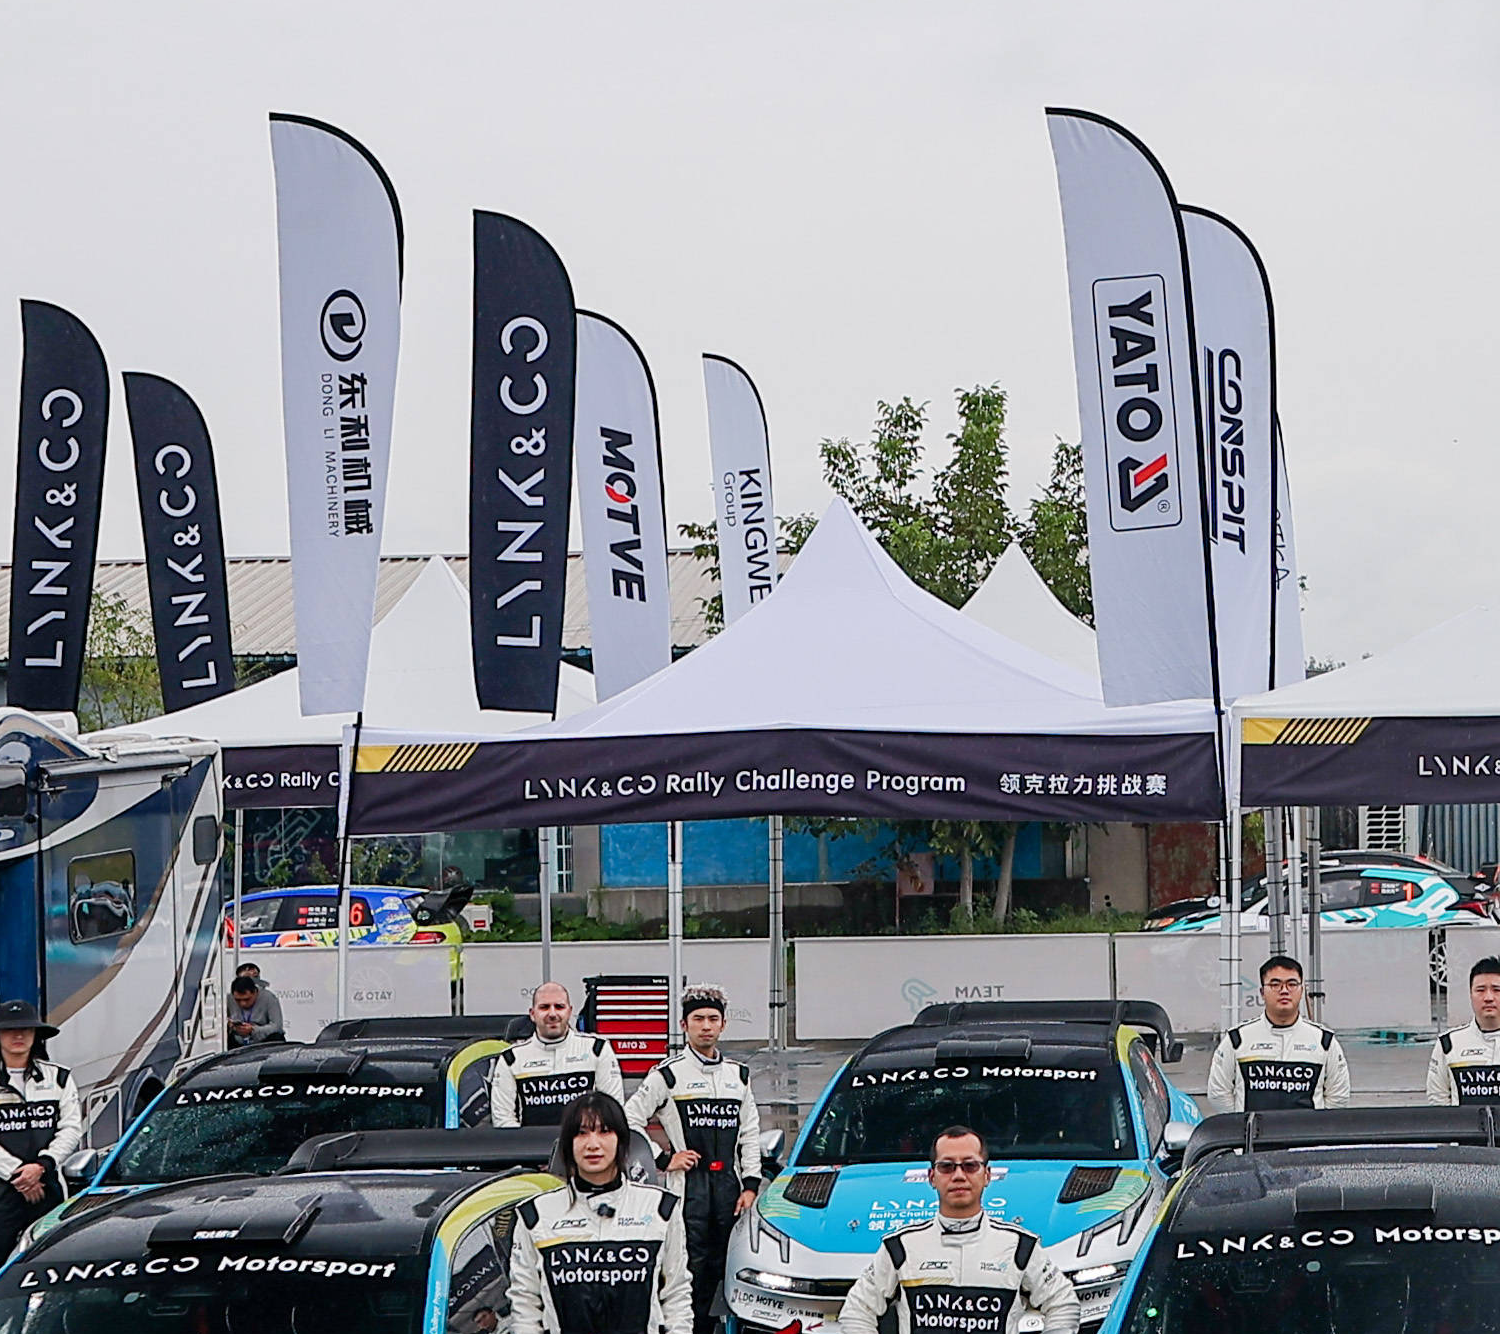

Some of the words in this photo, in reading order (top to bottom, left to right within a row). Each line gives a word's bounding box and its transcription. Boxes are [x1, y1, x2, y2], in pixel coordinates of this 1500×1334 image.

[1108, 290, 1163, 443] YATO
[321, 373, 334, 416] DONG
[324, 428, 335, 439] LI
[338, 372, 374, 536] 东利机械
[1216, 348, 1246, 555] CONSPIT
[496, 316, 549, 647] LYNK&CO
[325, 450, 339, 536] MACHINERY
[724, 472, 736, 527] Group
[599, 427, 646, 602] MOTVE
[24, 388, 85, 668] LYNK&CO
[739, 469, 772, 603] KINGWE
[155, 443, 216, 689] LYNK&CO
[222, 774, 274, 790] K&CO
[280, 771, 321, 790] Rally
[524, 777, 656, 800] LYNK&CO
[667, 771, 724, 797] Rally
[735, 768, 855, 796] Challenge
[866, 771, 966, 797] Program
[1000, 774, 1167, 796] 领克拉力挑战赛
[1402, 881, 1413, 902] 1
[350, 902, 363, 926] 6
[618, 1042, 637, 1050] YATO
[852, 1067, 969, 1088] LYNK&CO
[982, 1068, 1097, 1081] Motorsport
[1248, 1065, 1314, 1079] LYNK&CO
[176, 1085, 295, 1106] LYNK&CO
[306, 1084, 424, 1098] Motorsport
[522, 1077, 588, 1093] LYNK&CO
[1250, 1078, 1311, 1092] Motorsport
[687, 1103, 739, 1117] LYNK&CO
[1177, 1229, 1354, 1259] LYNK&CO
[550, 1248, 649, 1267] LYNK&CO
[21, 1256, 200, 1287] LYNK&CO
[218, 1255, 397, 1278] Motorsport
[552, 1267, 647, 1287] Motorsport
[756, 1296, 784, 1309] MOTVE
[915, 1295, 1000, 1311] LYNK&CO
[916, 1314, 999, 1332] Motorsport
